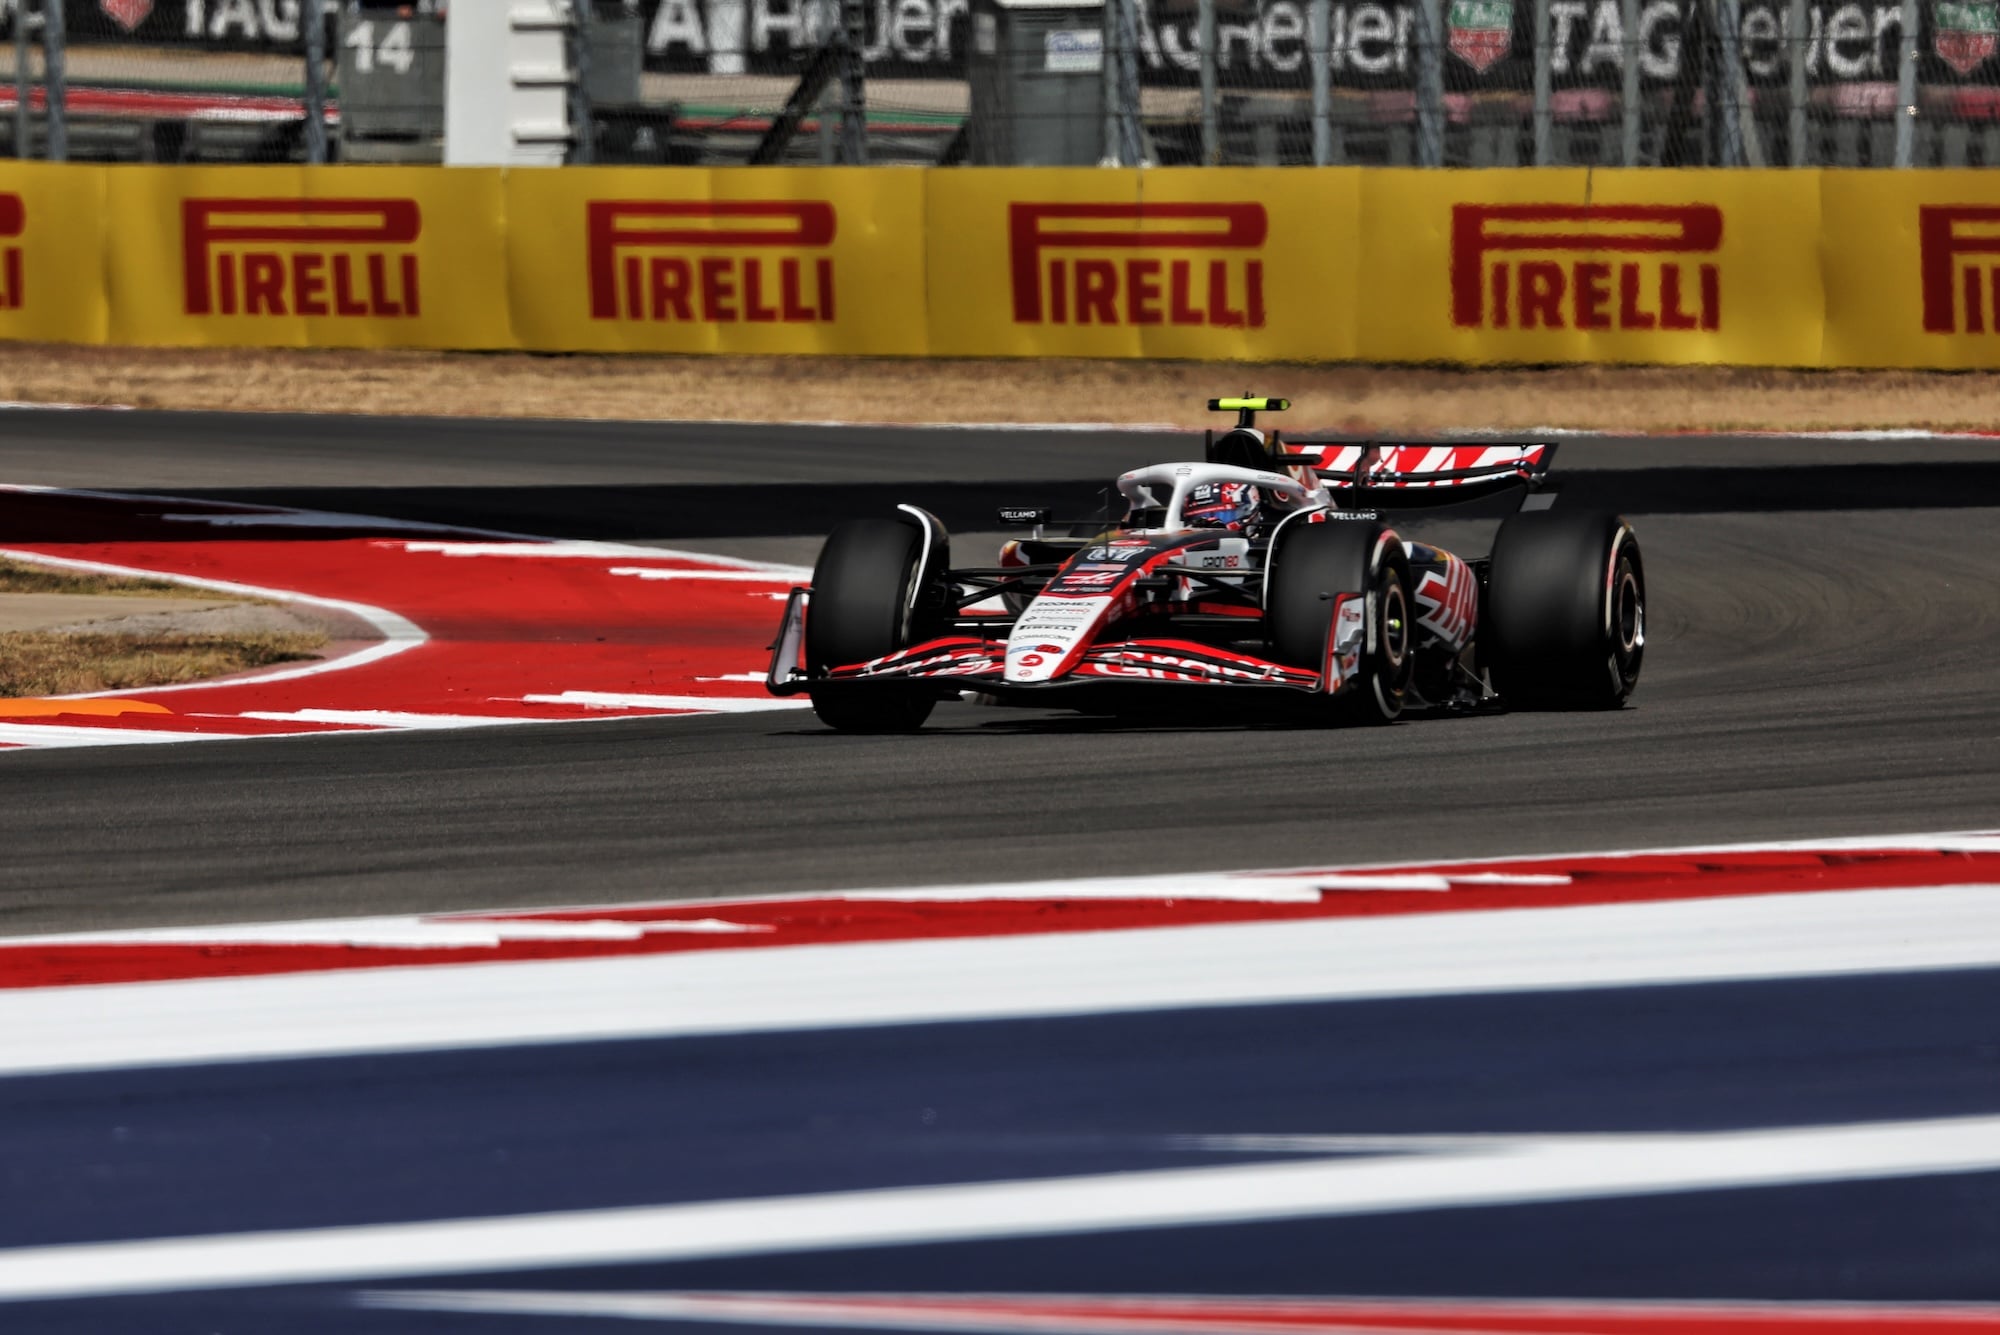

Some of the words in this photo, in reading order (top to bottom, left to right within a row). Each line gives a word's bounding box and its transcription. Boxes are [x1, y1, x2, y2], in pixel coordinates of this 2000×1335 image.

[345, 20, 414, 74] 14
[182, 199, 421, 316] PIRELLI
[587, 201, 837, 322] PIRELLI
[1008, 202, 1268, 327] PIRELLI
[1451, 204, 1723, 330] PIRELLI
[1000, 510, 1037, 519] VELLAMO
[1331, 512, 1378, 521] VELLAMO
